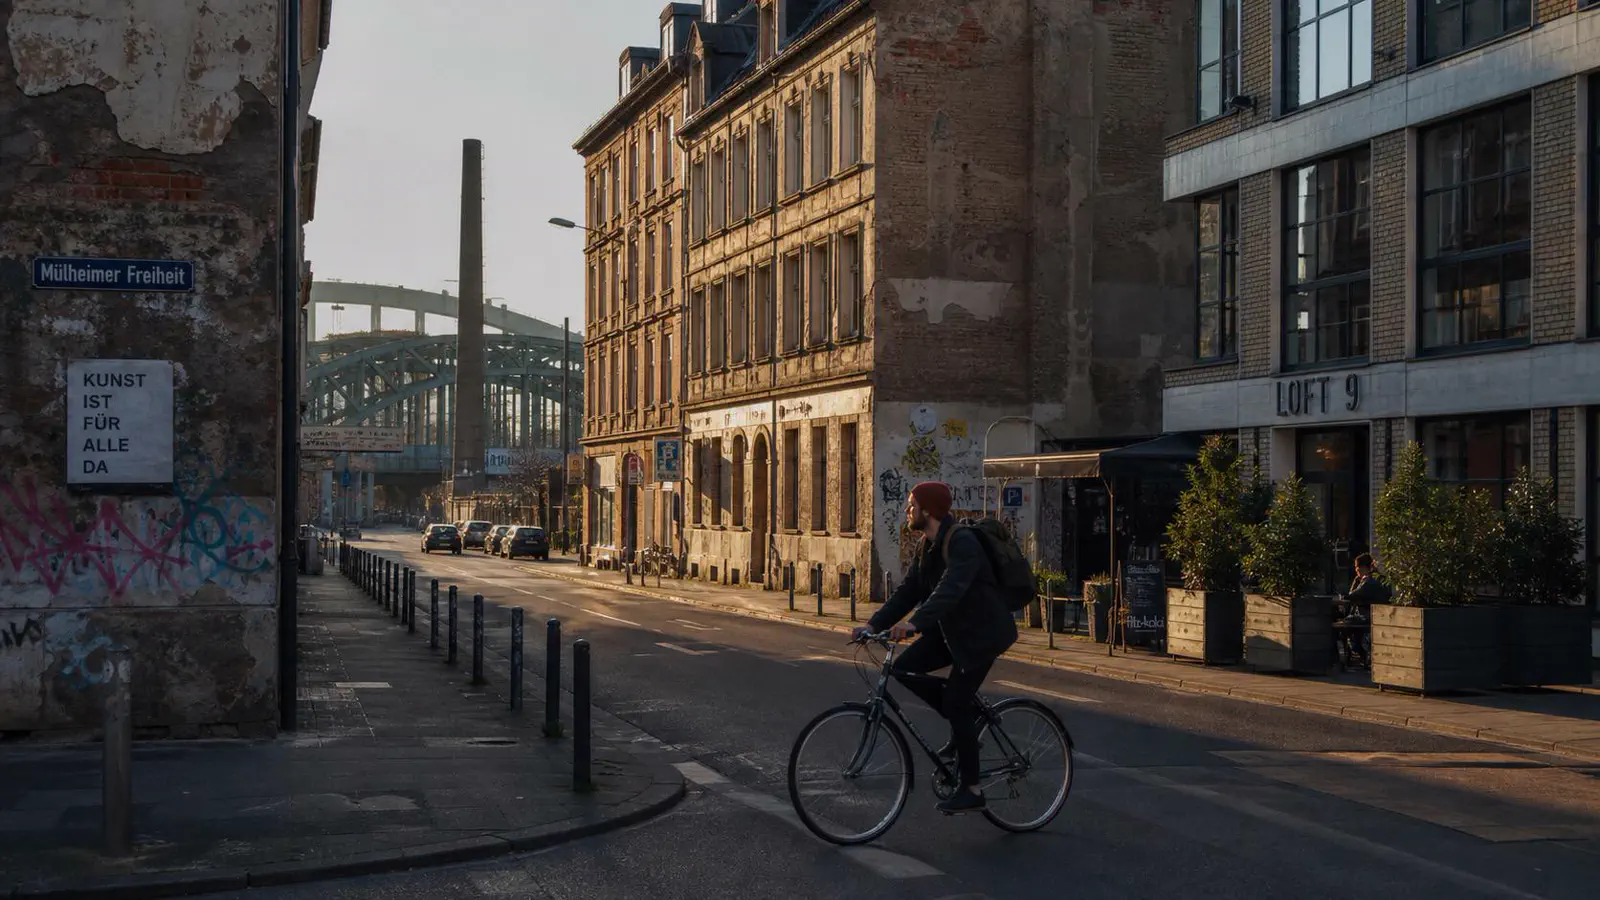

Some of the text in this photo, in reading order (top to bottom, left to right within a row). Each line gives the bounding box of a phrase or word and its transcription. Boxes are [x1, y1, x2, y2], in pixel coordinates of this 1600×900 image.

[40, 263, 186, 285] Mülheimer Freiheit
[83, 373, 146, 388] KUNST
[83, 394, 112, 409] IST
[1276, 373, 1360, 416] LOFT 9
[83, 412, 120, 430] FÜR
[83, 438, 129, 452] ALLE
[83, 460, 108, 474] DA
